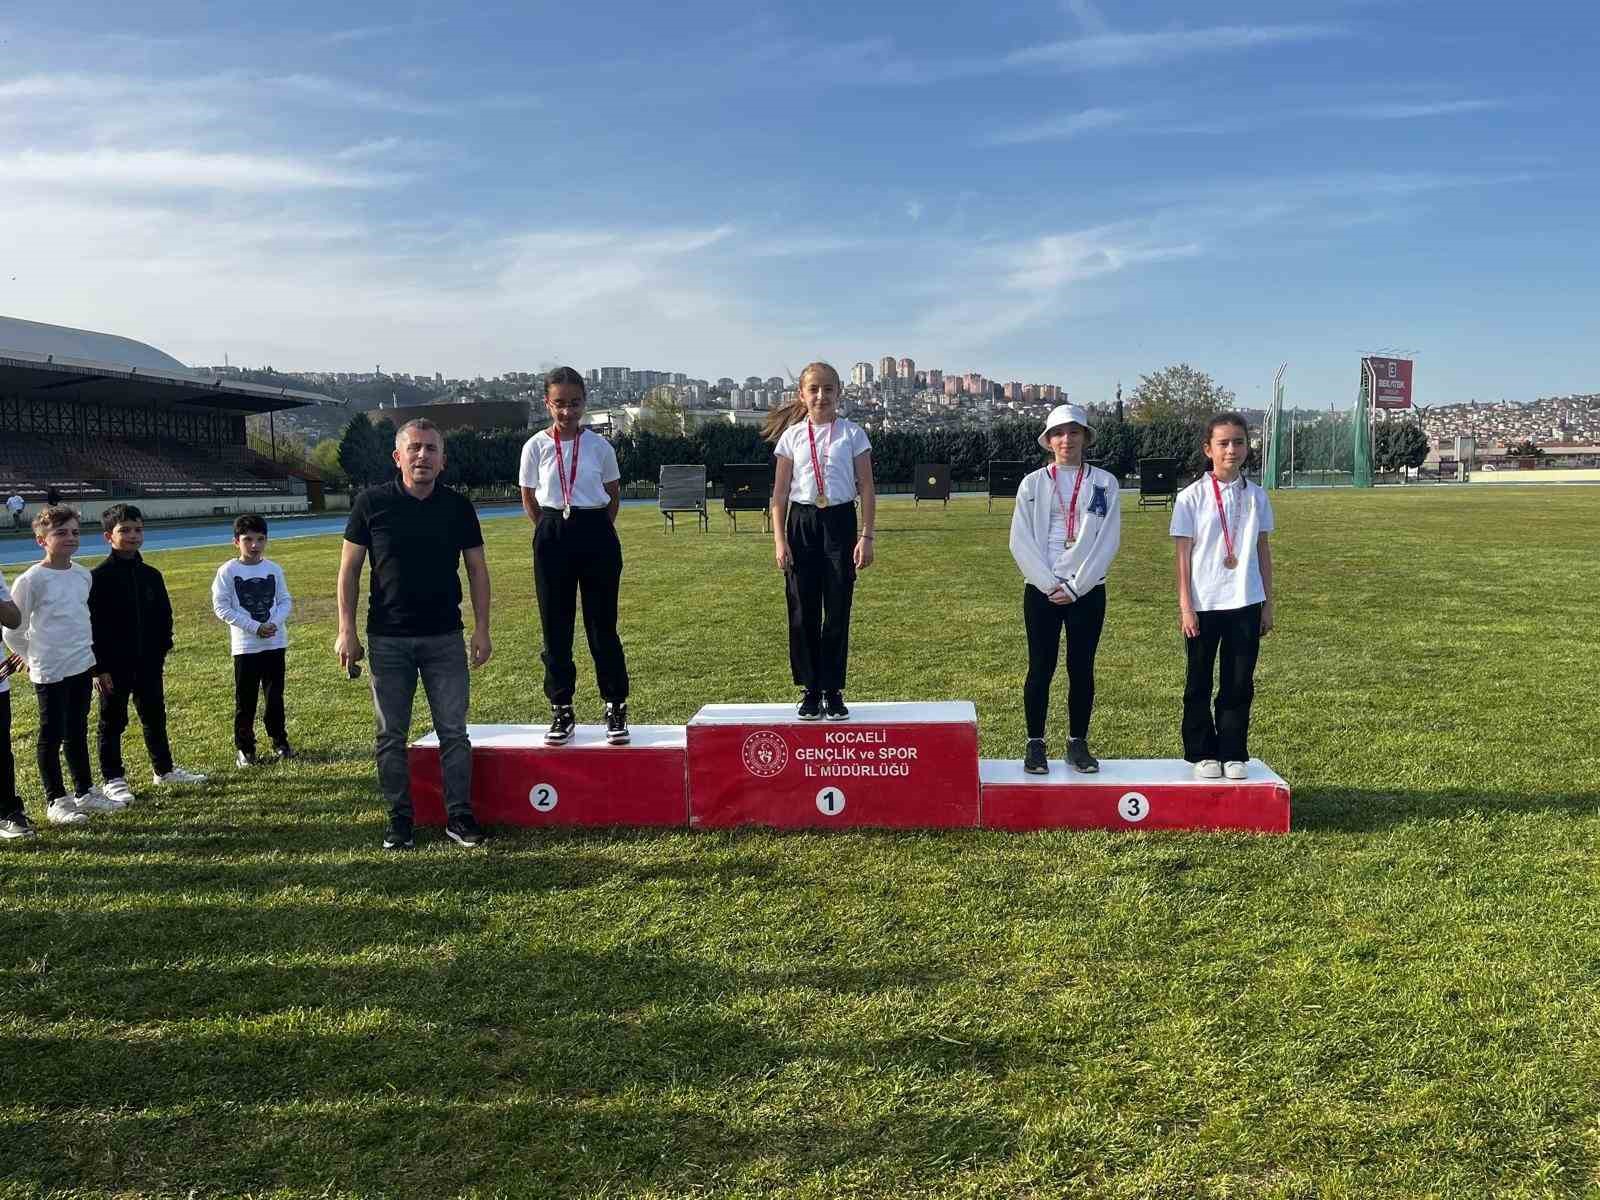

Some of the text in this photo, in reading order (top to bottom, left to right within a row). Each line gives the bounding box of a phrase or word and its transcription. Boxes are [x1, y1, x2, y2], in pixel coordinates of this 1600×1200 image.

[825, 729, 887, 744] KOCAELİ
[795, 746, 918, 762] GENÇLİK ve SPOR
[804, 763, 910, 777] İL MÜDÜRLÜĞÜ
[537, 788, 550, 806] 2
[823, 791, 835, 811] 1
[1127, 798, 1140, 817] 3
